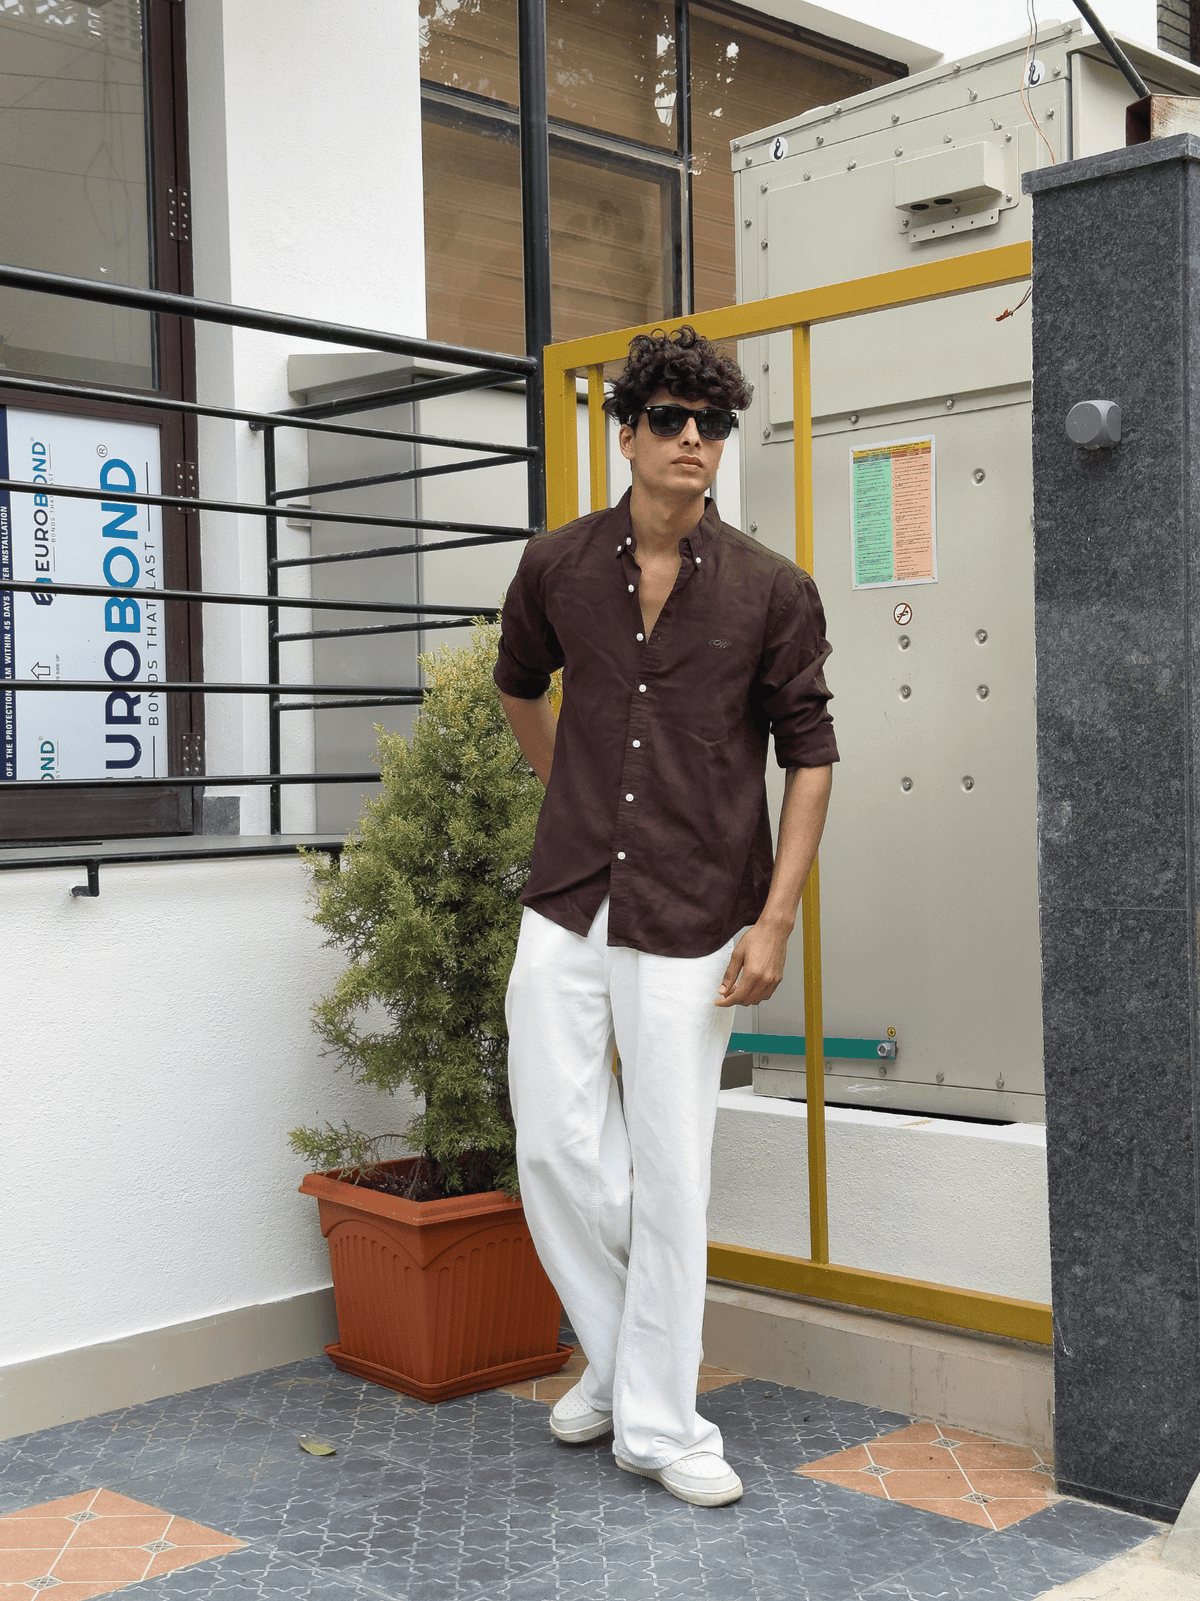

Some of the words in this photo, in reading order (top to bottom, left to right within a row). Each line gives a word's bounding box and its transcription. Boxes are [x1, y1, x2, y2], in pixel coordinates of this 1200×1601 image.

[0, 506, 9, 564] INSTALLATION
[144, 541, 156, 590] LAST
[2, 596, 11, 617] DAYS
[100, 458, 142, 778] UROBOND
[3, 620, 11, 630] 45
[145, 600, 158, 650] THAT
[4, 634, 12, 664] WITHIN
[5, 743, 13, 759] THE
[5, 762, 13, 777] OFF
